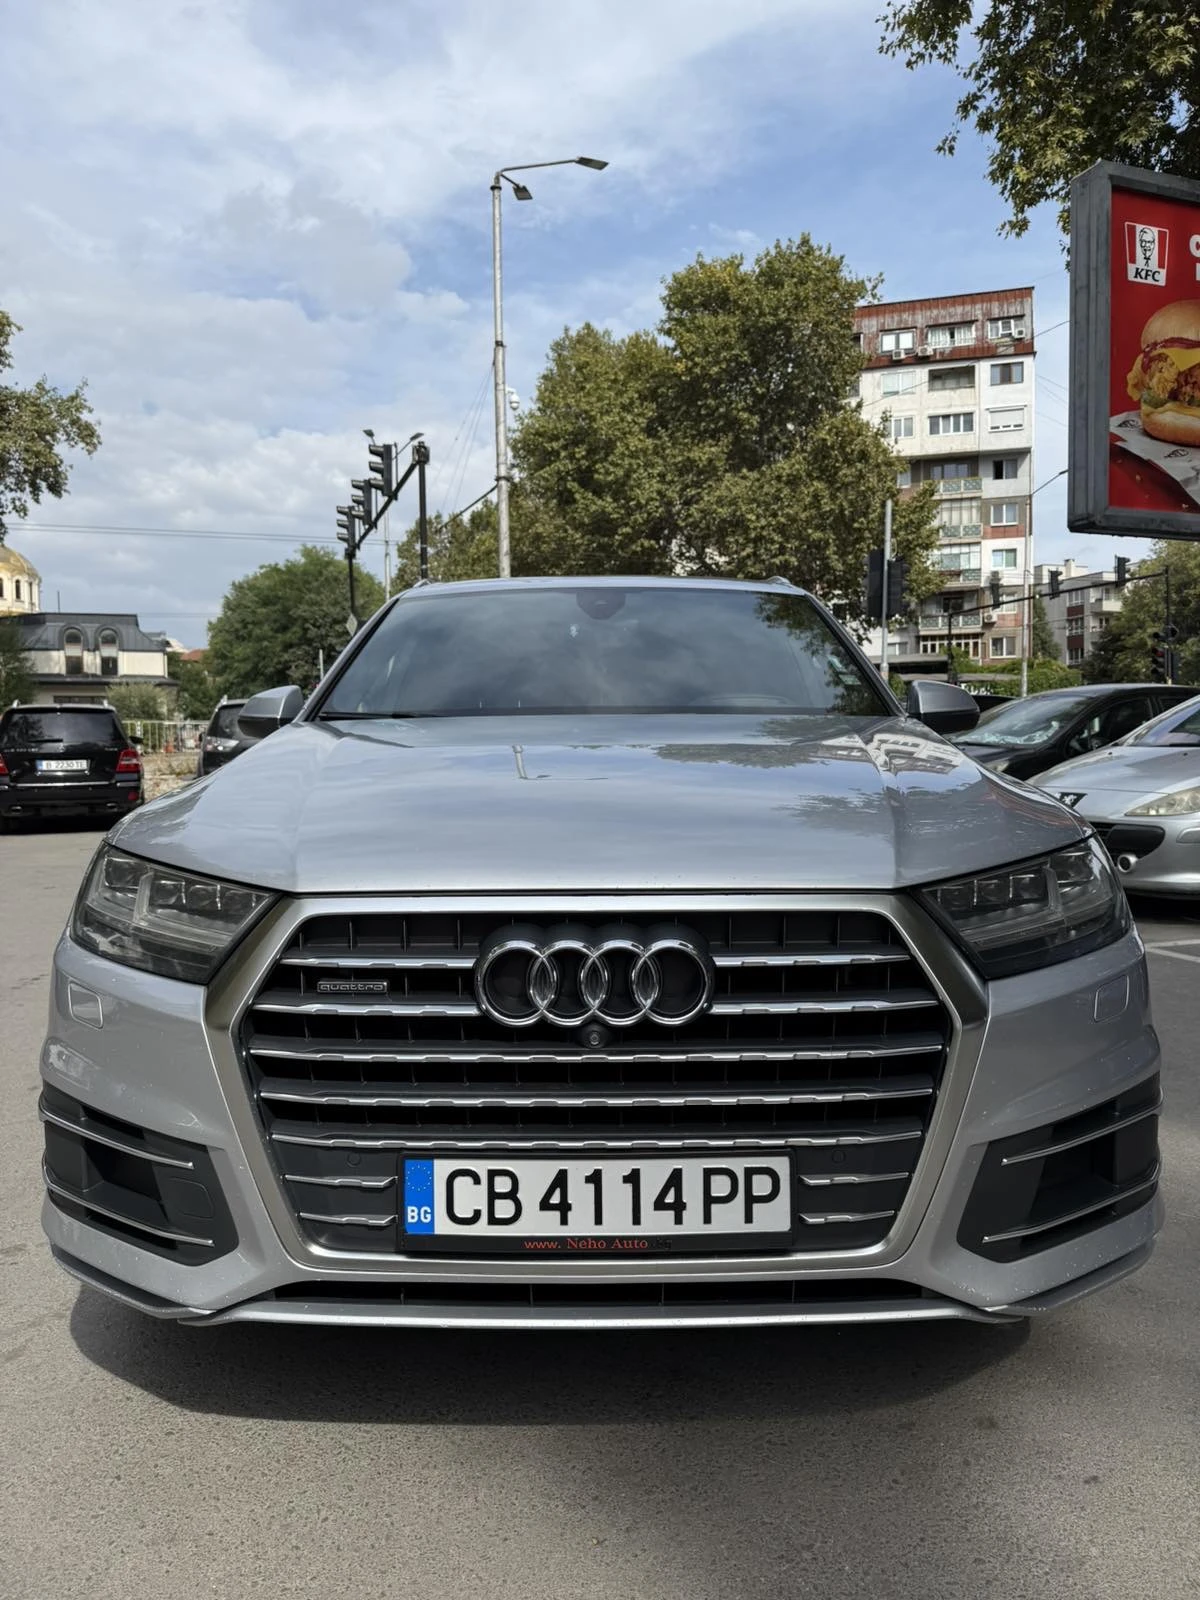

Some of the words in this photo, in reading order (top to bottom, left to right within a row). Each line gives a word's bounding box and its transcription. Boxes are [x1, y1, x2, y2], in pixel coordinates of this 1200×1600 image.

[1133, 267, 1161, 282] KFC
[319, 983, 384, 991] quattro
[445, 1168, 523, 1226] CB
[539, 1168, 687, 1226] 4114
[702, 1166, 781, 1225] PP
[407, 1206, 432, 1223] BG
[524, 1241, 561, 1249] www.
[567, 1238, 607, 1249] Neho
[611, 1238, 648, 1249] Auto
